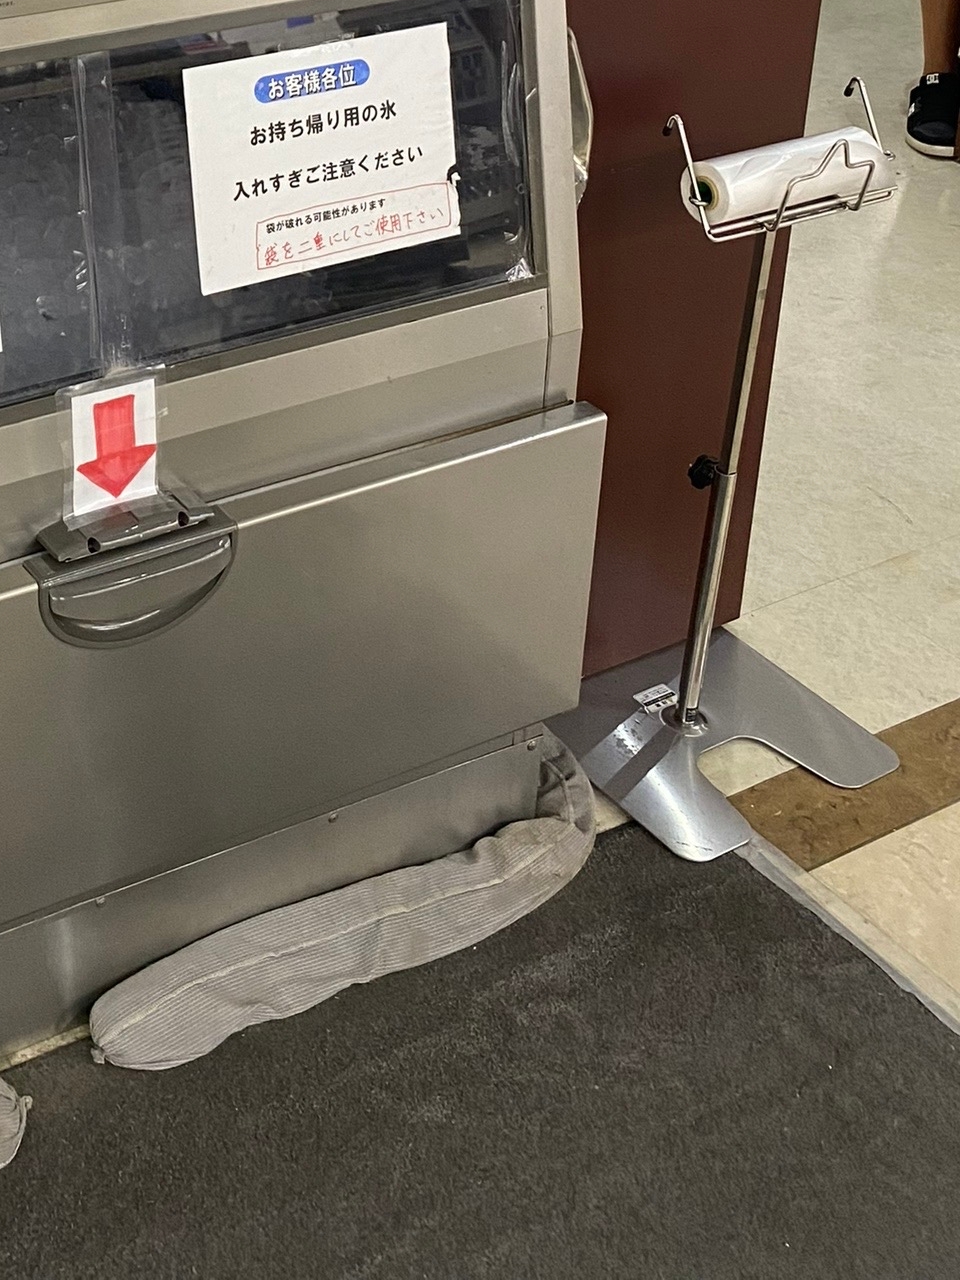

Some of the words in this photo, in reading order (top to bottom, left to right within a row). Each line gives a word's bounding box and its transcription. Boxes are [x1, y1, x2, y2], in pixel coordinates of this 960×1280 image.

[267, 63, 358, 102] お客様各位
[249, 98, 398, 147] お持ち帰り用の氷
[232, 145, 425, 203] 入れすぎご注意ください
[264, 206, 444, 266] 袋を二重にしてご使用下さい
[265, 198, 386, 234] 袋が破れる可能性があります
